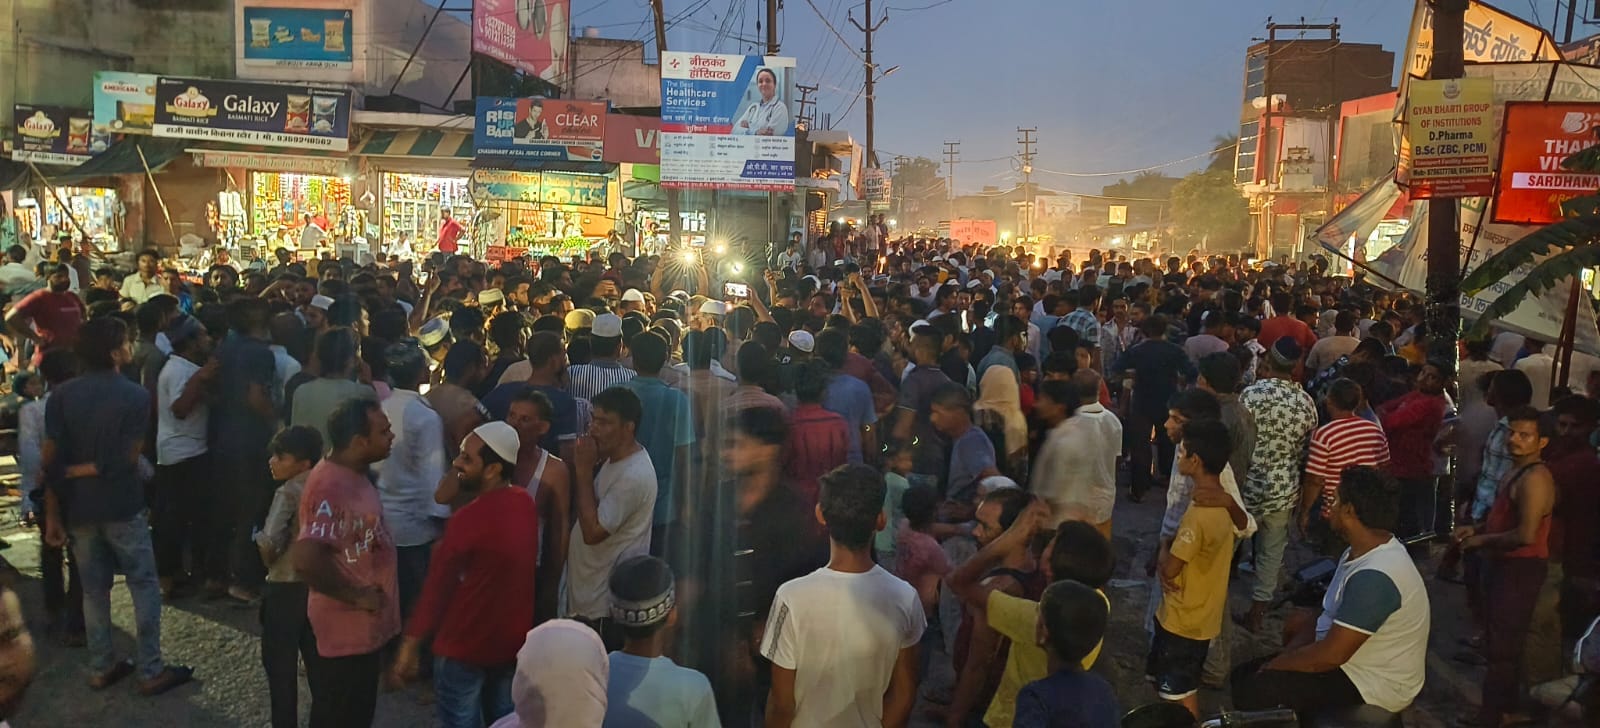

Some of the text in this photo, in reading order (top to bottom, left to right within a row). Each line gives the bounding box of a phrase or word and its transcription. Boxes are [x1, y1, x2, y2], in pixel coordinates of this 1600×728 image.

[667, 88, 716, 98] Healthcare
[175, 96, 209, 111] Galaxy
[223, 94, 281, 120] Galaxy
[667, 98, 706, 107] Services
[1413, 104, 1490, 115] GYAN BHARTI GROUP
[486, 110, 517, 123] RIS
[555, 114, 598, 127] CLEAR
[25, 120, 53, 132] Galaxy
[497, 120, 514, 129] UP
[1421, 117, 1482, 128] OF INSTITUTIONS
[1429, 131, 1473, 141] D.Pharma
[1415, 146, 1435, 155] B.Sc
[1463, 143, 1487, 153] PCM)
[866, 177, 883, 187] CNG
[1528, 175, 1600, 188] SARDHANA
